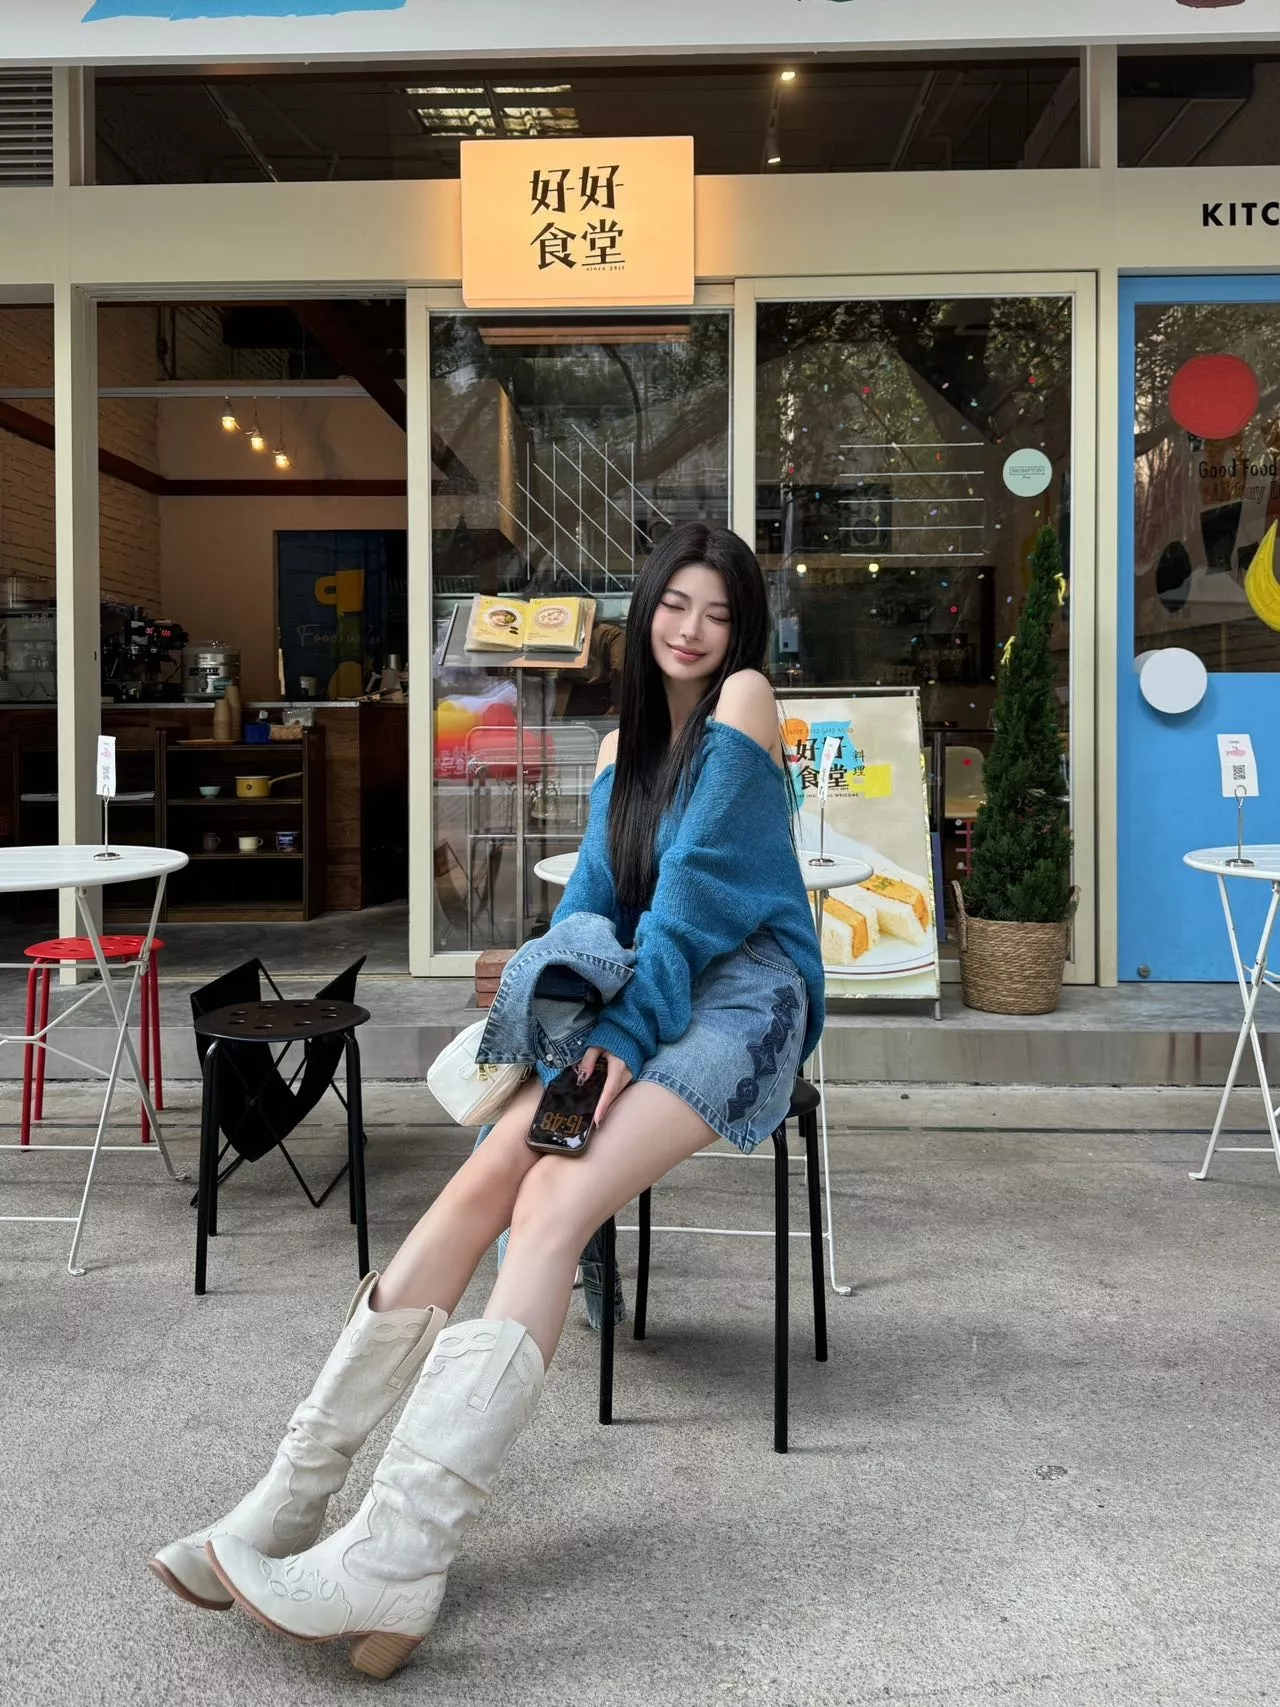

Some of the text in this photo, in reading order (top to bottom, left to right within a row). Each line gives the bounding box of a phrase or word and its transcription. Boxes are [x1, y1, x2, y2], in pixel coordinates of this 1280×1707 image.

[529, 165, 624, 216] 好好
[1202, 201, 1280, 226] KITC
[530, 218, 626, 271] 食堂
[1199, 456, 1277, 479] Good Food
[852, 749, 866, 777] 料理
